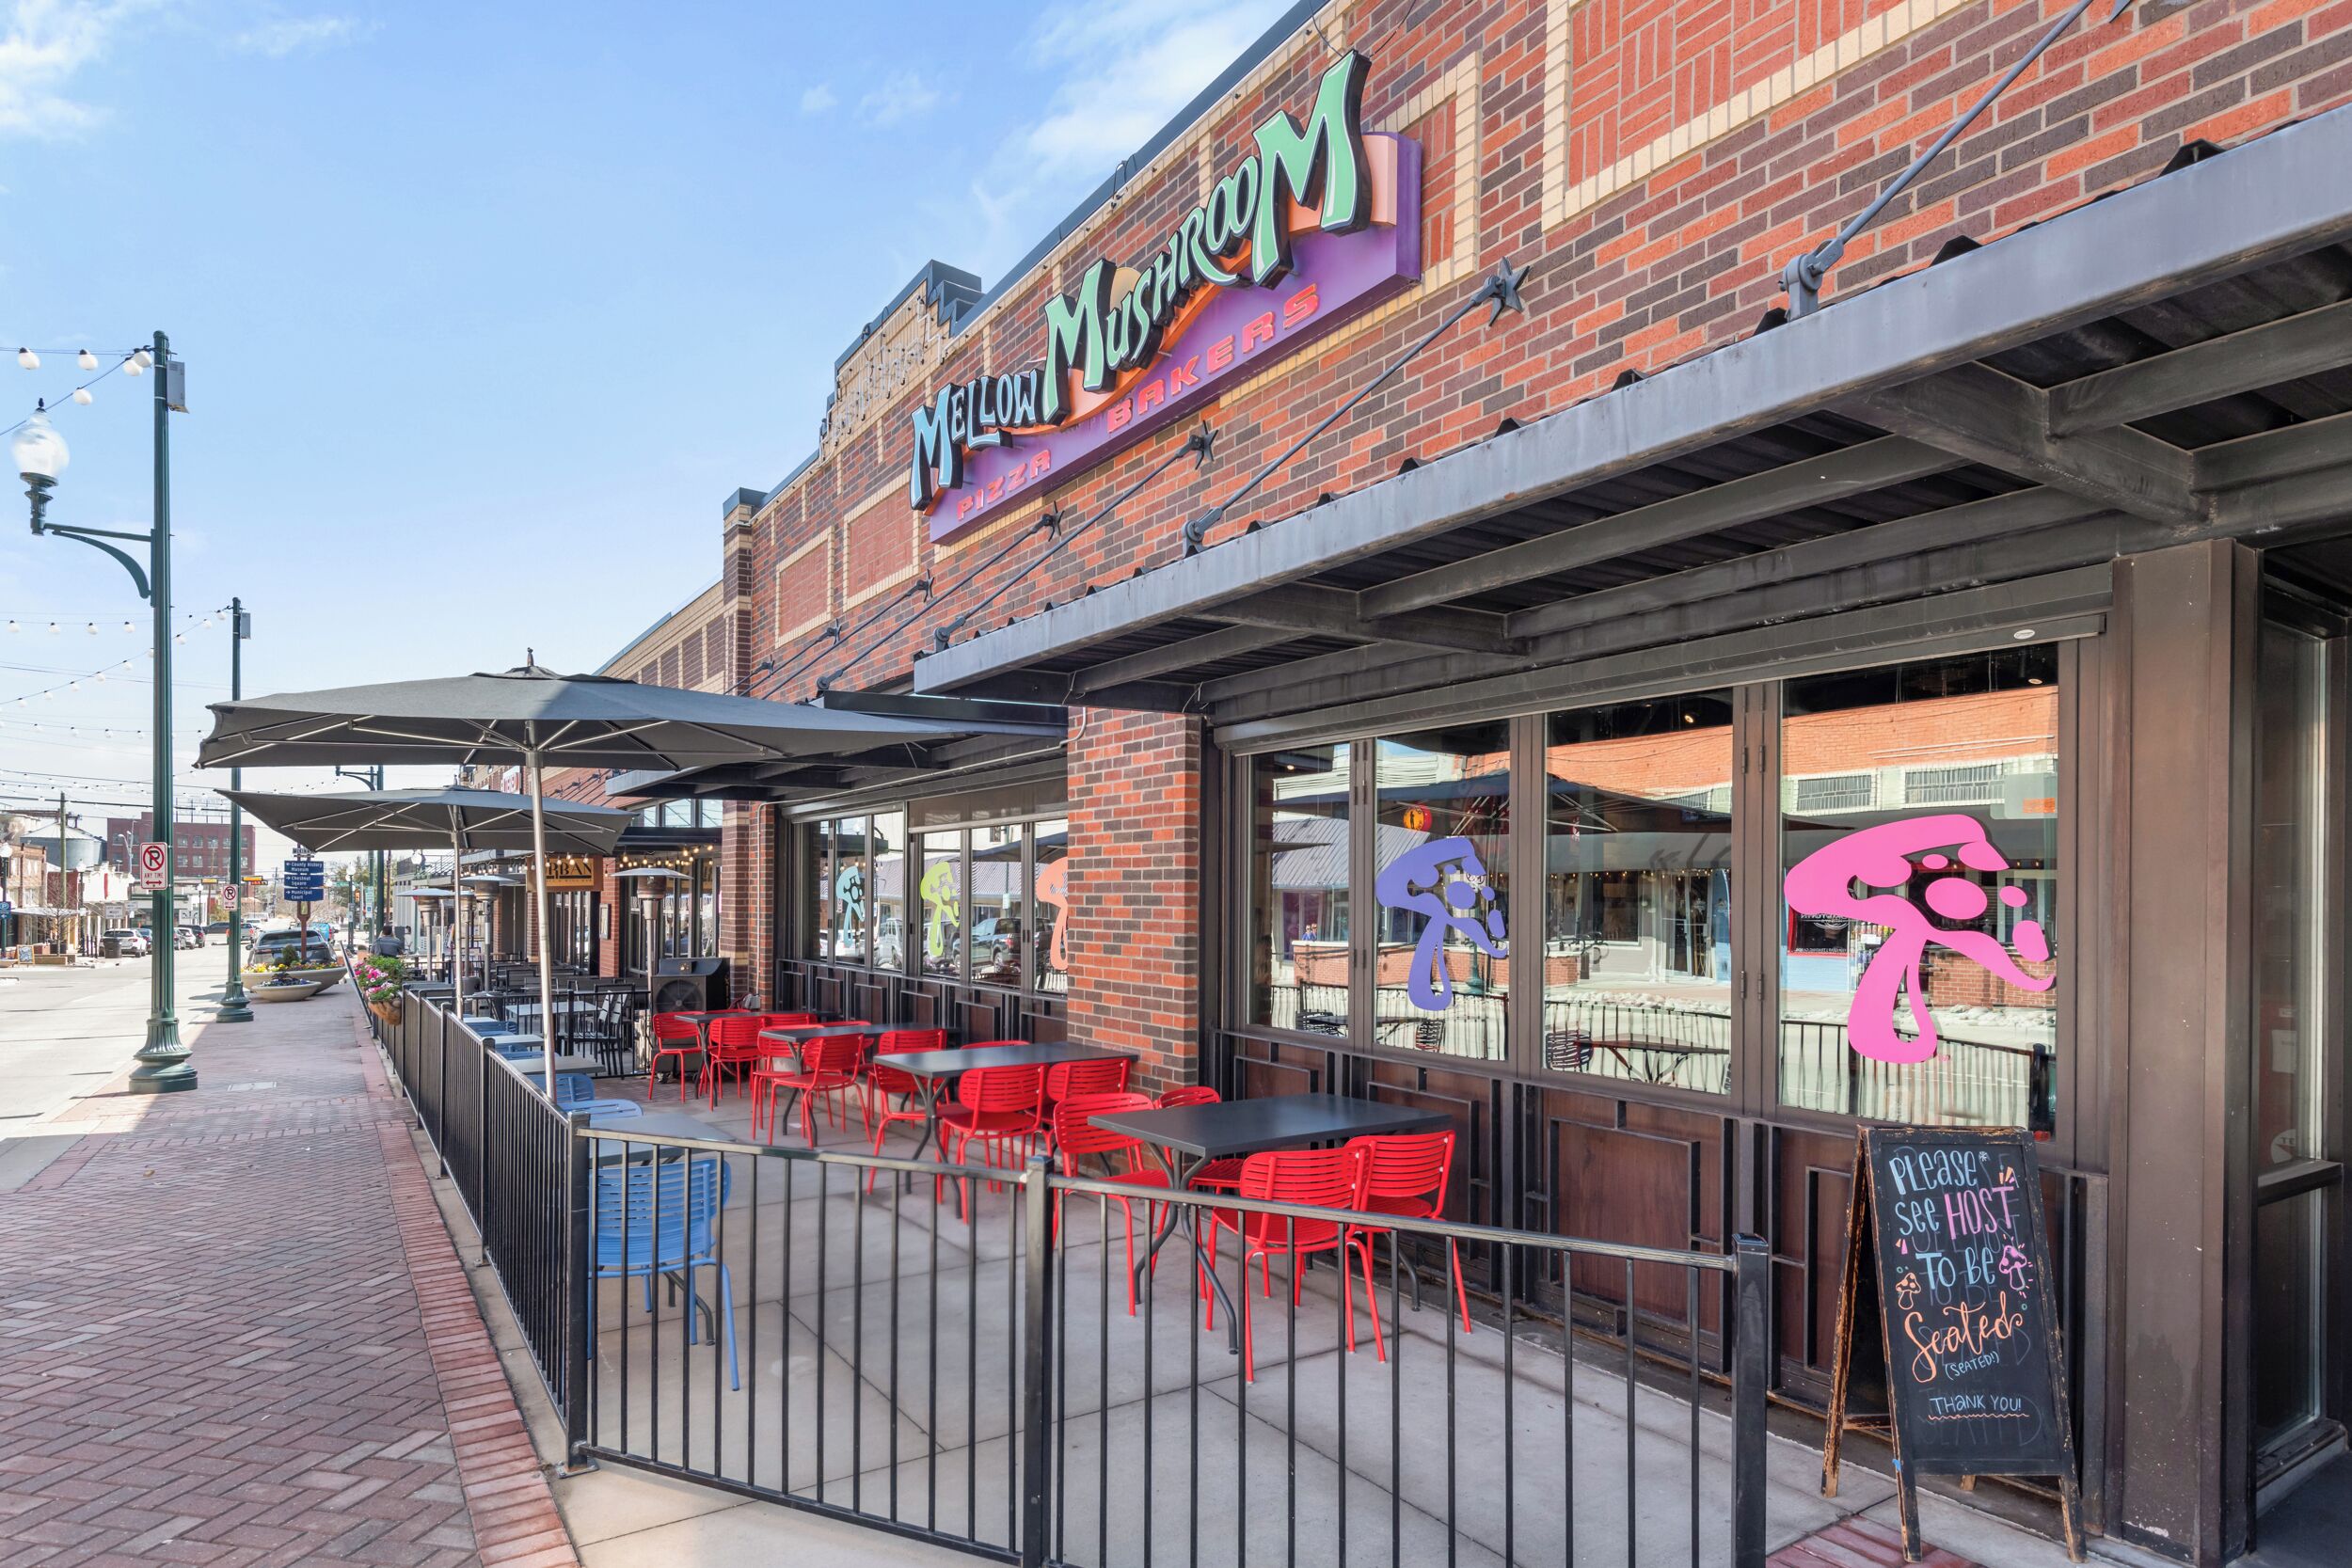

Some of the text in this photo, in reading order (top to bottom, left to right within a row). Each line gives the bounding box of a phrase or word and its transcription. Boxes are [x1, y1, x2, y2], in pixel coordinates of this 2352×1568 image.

[912, 368, 1037, 508] MELLOW
[1041, 51, 1368, 425] MUSHROOM
[956, 283, 1320, 522] PIZZA BAKERS
[1944, 1186, 2014, 1240] HOST
[1904, 1291, 2023, 1383] Seated
[1990, 1396, 2022, 1412] YOU!
